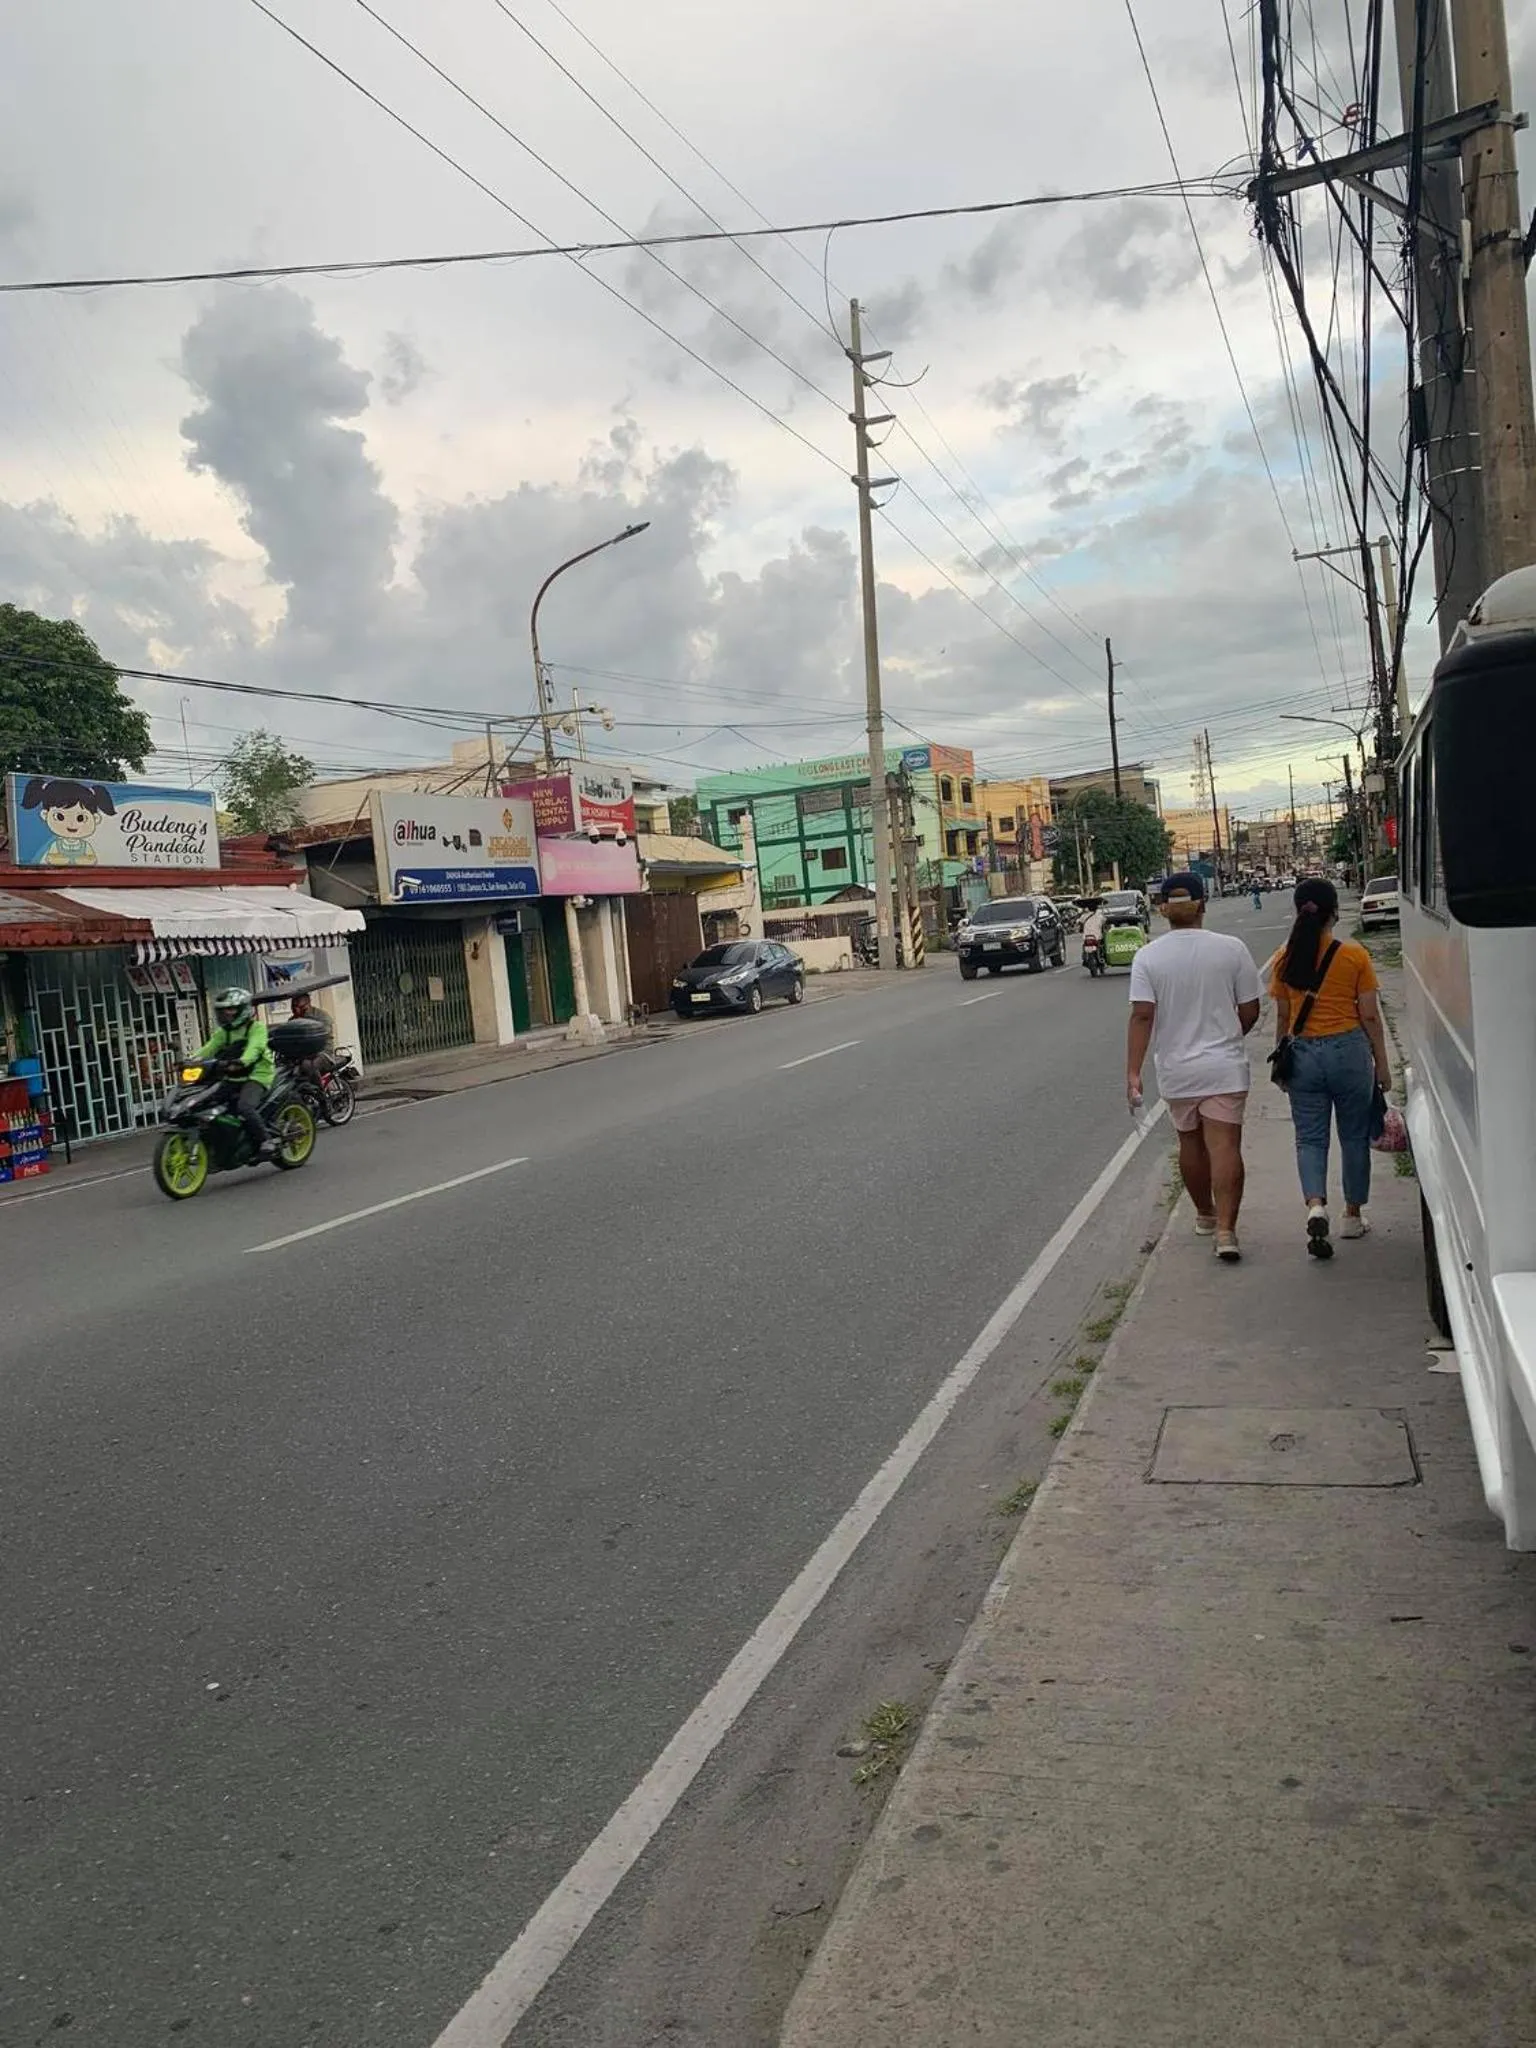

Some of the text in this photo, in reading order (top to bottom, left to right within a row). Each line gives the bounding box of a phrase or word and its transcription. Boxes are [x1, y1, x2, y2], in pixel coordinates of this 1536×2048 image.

[533, 788, 553, 798] NEW
[534, 796, 568, 808] TARLAC
[535, 806, 570, 818] DENTAL
[120, 809, 208, 843] Budeng's
[536, 815, 568, 827] SUPPLY
[126, 833, 205, 854] Pandesal
[131, 853, 205, 864] STATION
